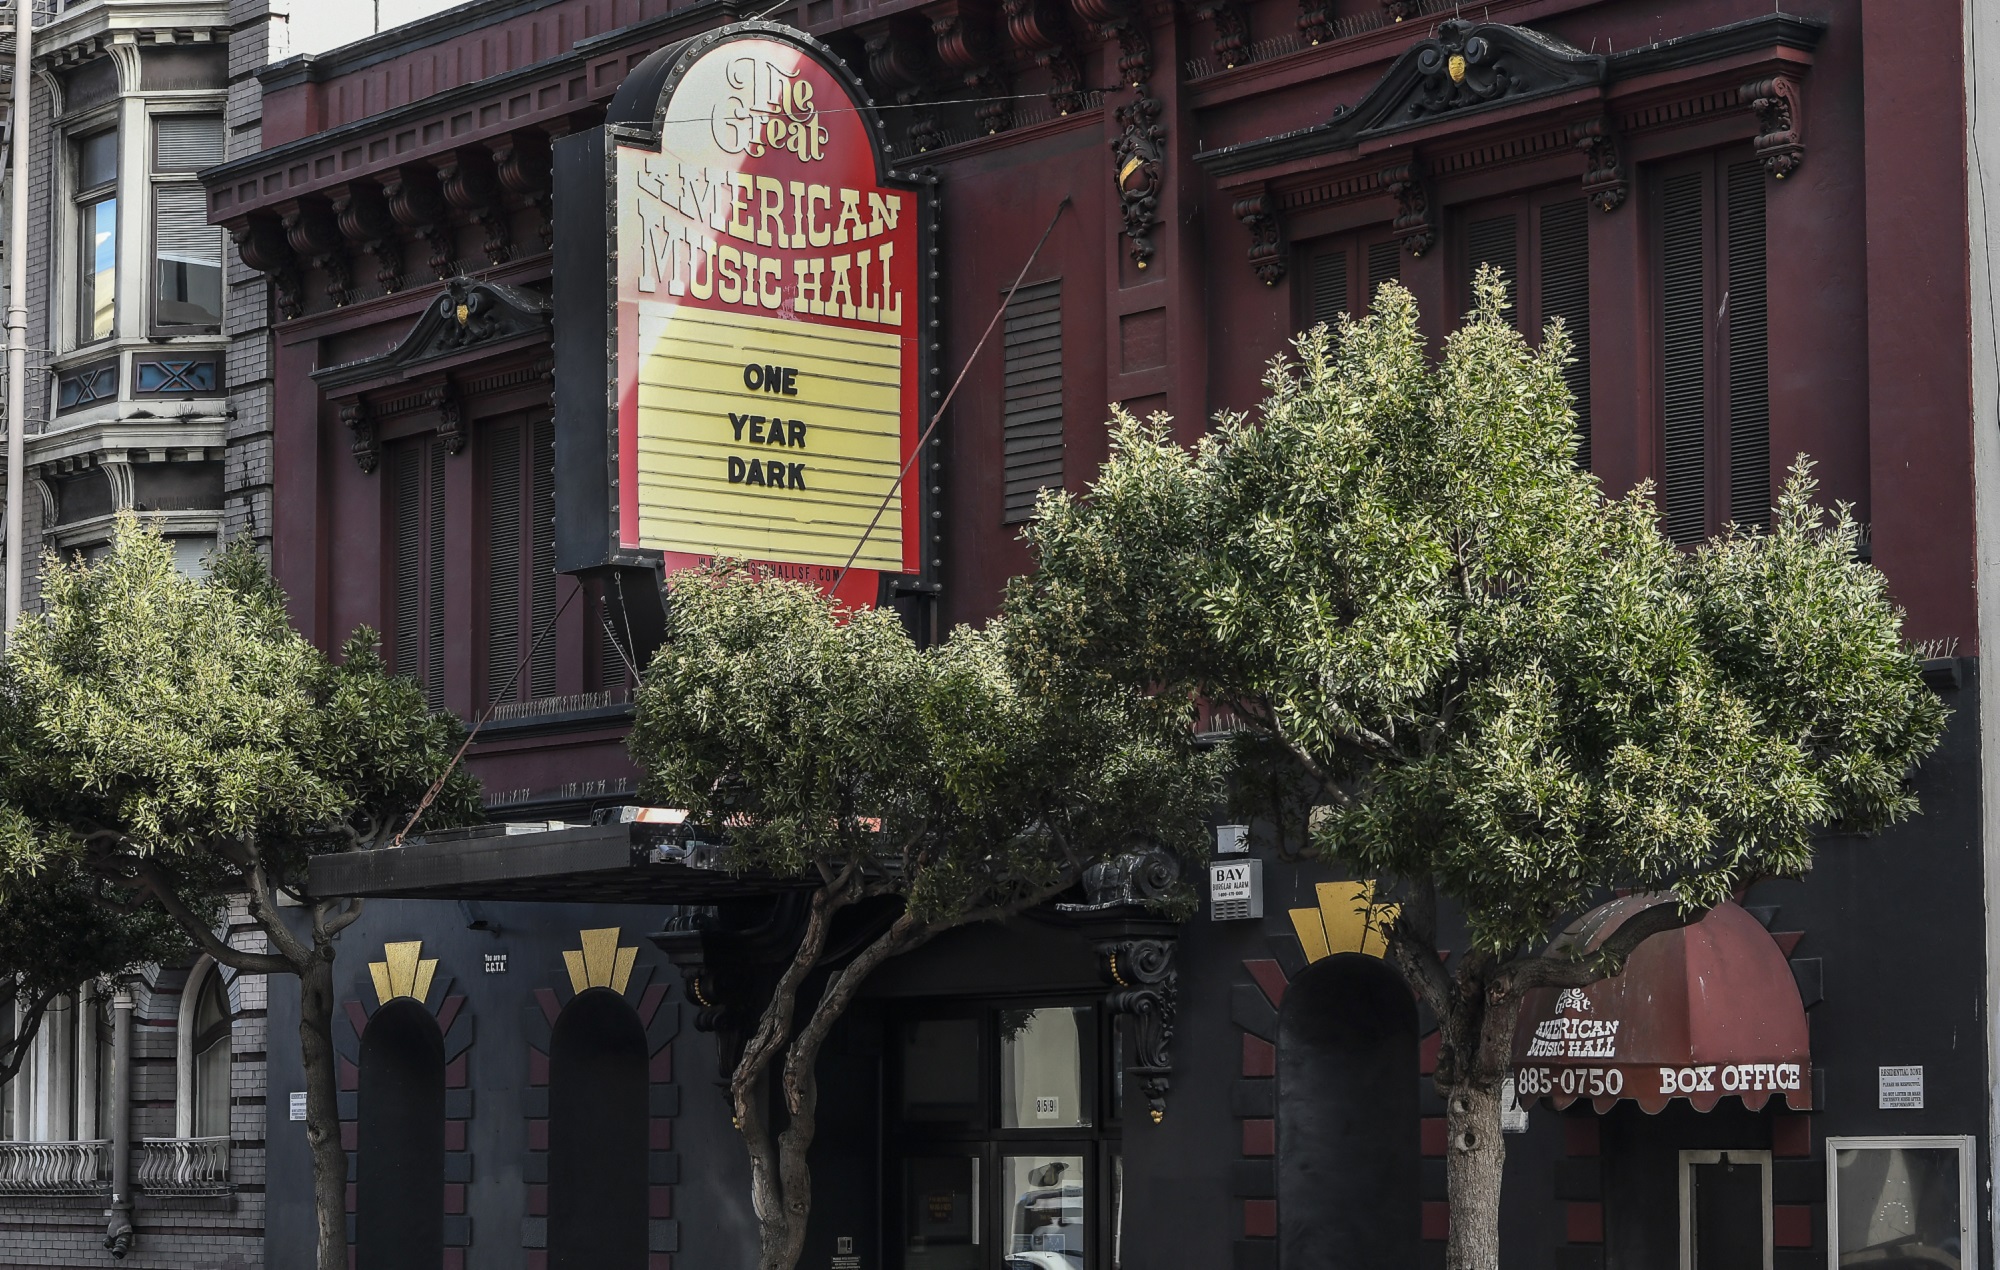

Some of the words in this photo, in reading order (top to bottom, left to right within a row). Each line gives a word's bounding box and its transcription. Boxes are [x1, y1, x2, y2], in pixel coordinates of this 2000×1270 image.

[725, 57, 815, 122] The
[711, 96, 829, 163] Great
[637, 158, 902, 250] AMERICAN
[637, 198, 783, 310] MUSIC
[793, 240, 903, 327] HALL
[743, 363, 799, 396] ONE
[727, 412, 808, 448] YEAR
[727, 456, 807, 491] DARK
[1213, 883, 1231, 891] BURGLAR
[1234, 881, 1248, 889] ALARM
[1217, 868, 1244, 881] BAY
[1535, 1018, 1620, 1040] AMERICAN
[1526, 1037, 1565, 1057] MUSIC
[1567, 1036, 1616, 1057] HALL
[1518, 1067, 1624, 1096] 885-0750
[1659, 1065, 1717, 1093] BOX
[1721, 1063, 1800, 1091] OFFICE
[1036, 1099, 1054, 1113] 859
